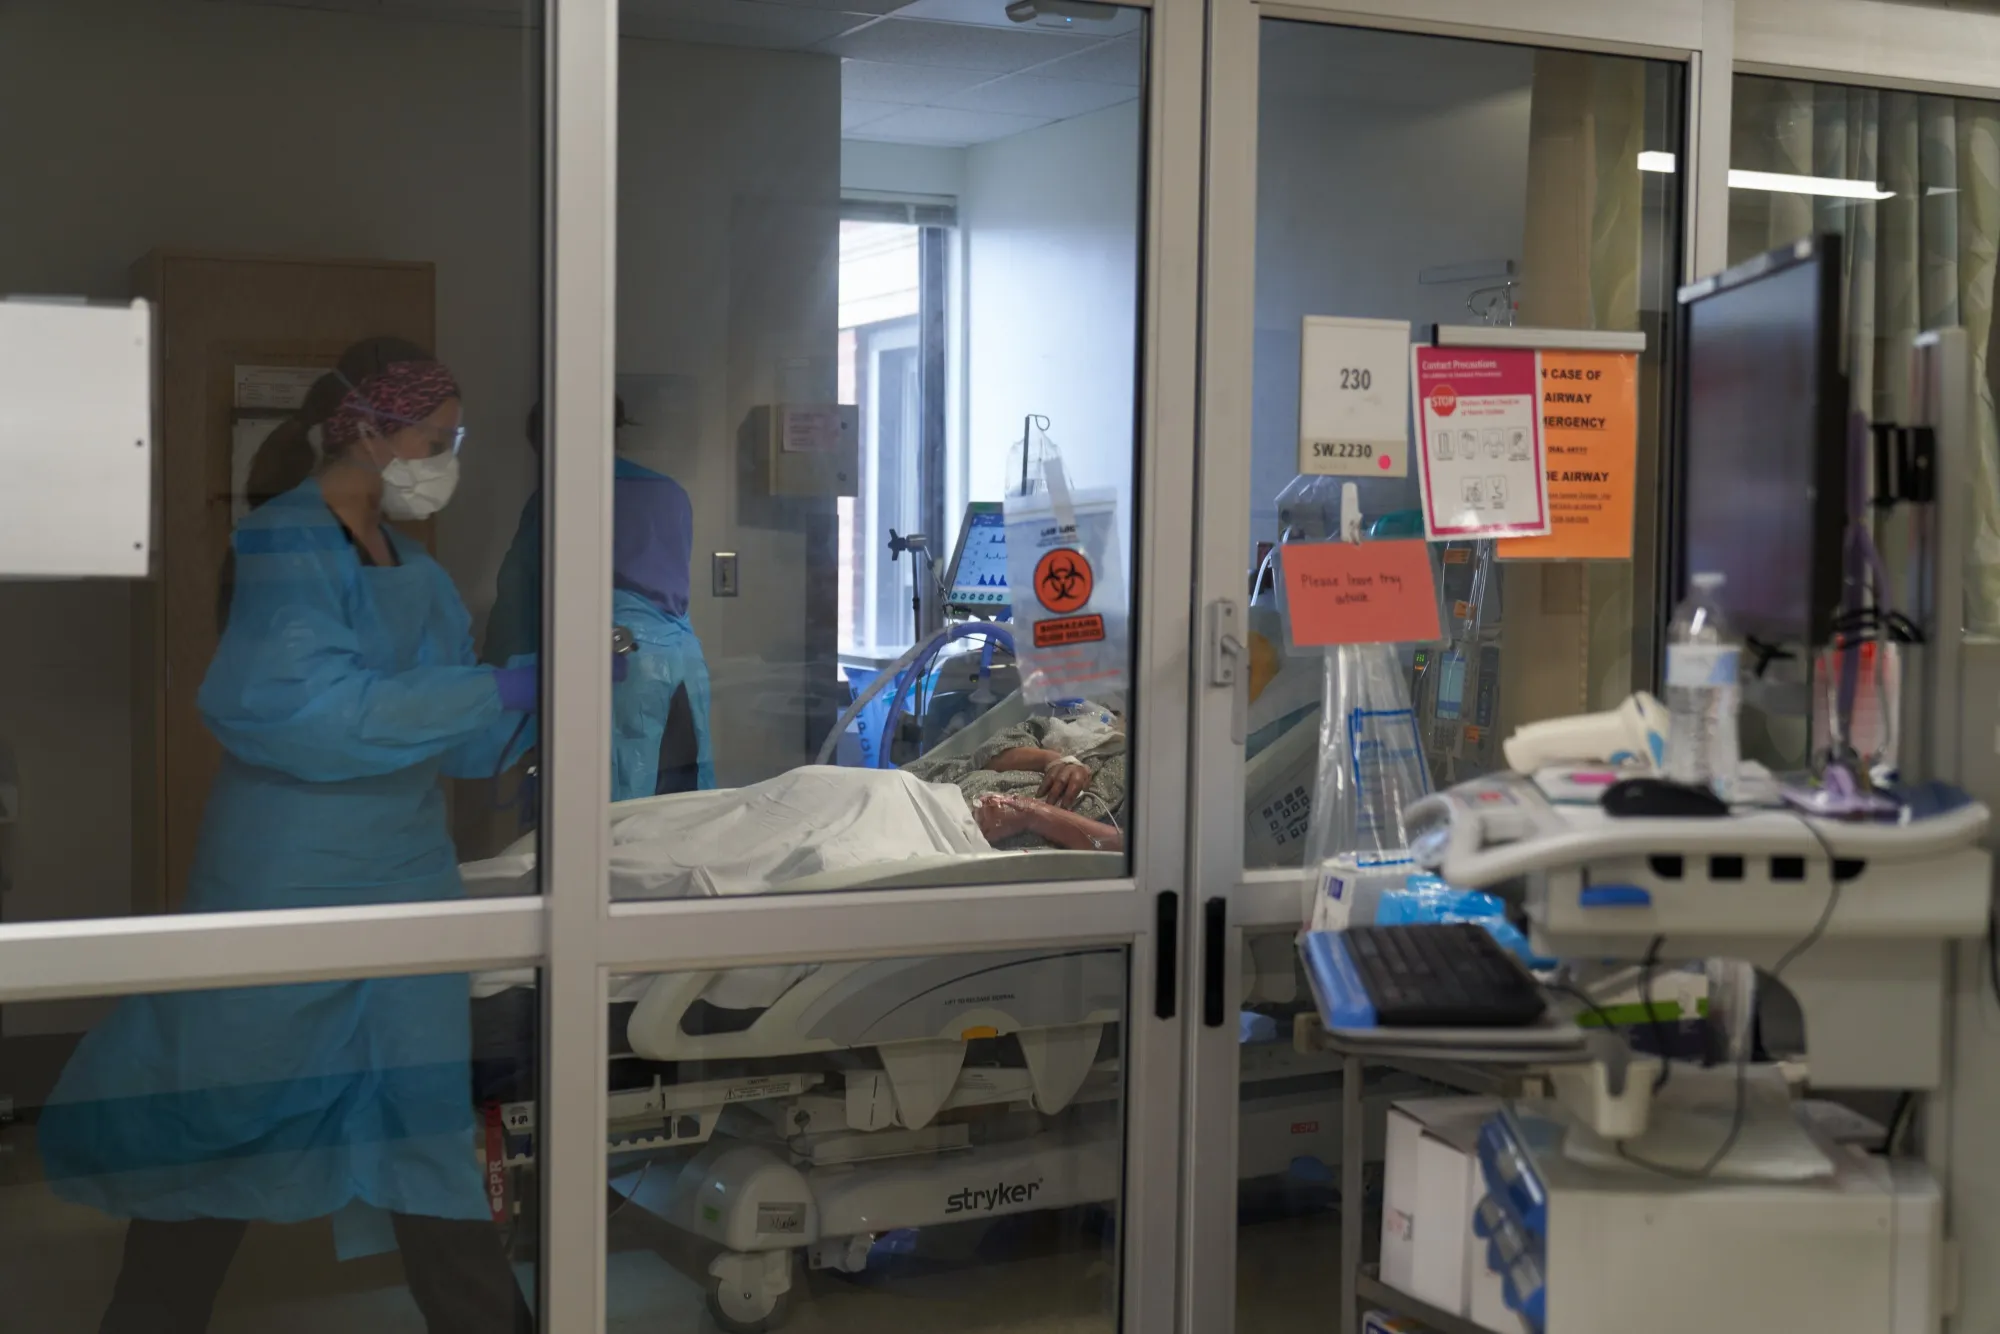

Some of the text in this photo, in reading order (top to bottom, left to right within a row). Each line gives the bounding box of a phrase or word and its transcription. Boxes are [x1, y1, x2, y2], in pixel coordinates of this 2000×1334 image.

[1422, 360, 1497, 370] Contact Precautions
[1340, 368, 1371, 390] 230
[1541, 368, 1602, 381] N CASE OF
[1432, 395, 1454, 407] STOP
[1544, 392, 1592, 403] AIRWAY
[1543, 415, 1606, 428] ERGENCY
[1313, 443, 1372, 458] SW.2230
[1562, 471, 1609, 482] AIRWAY
[1301, 573, 1339, 588] Please
[490, 1160, 503, 1196] CPR
[945, 1182, 1039, 1214] stryker
